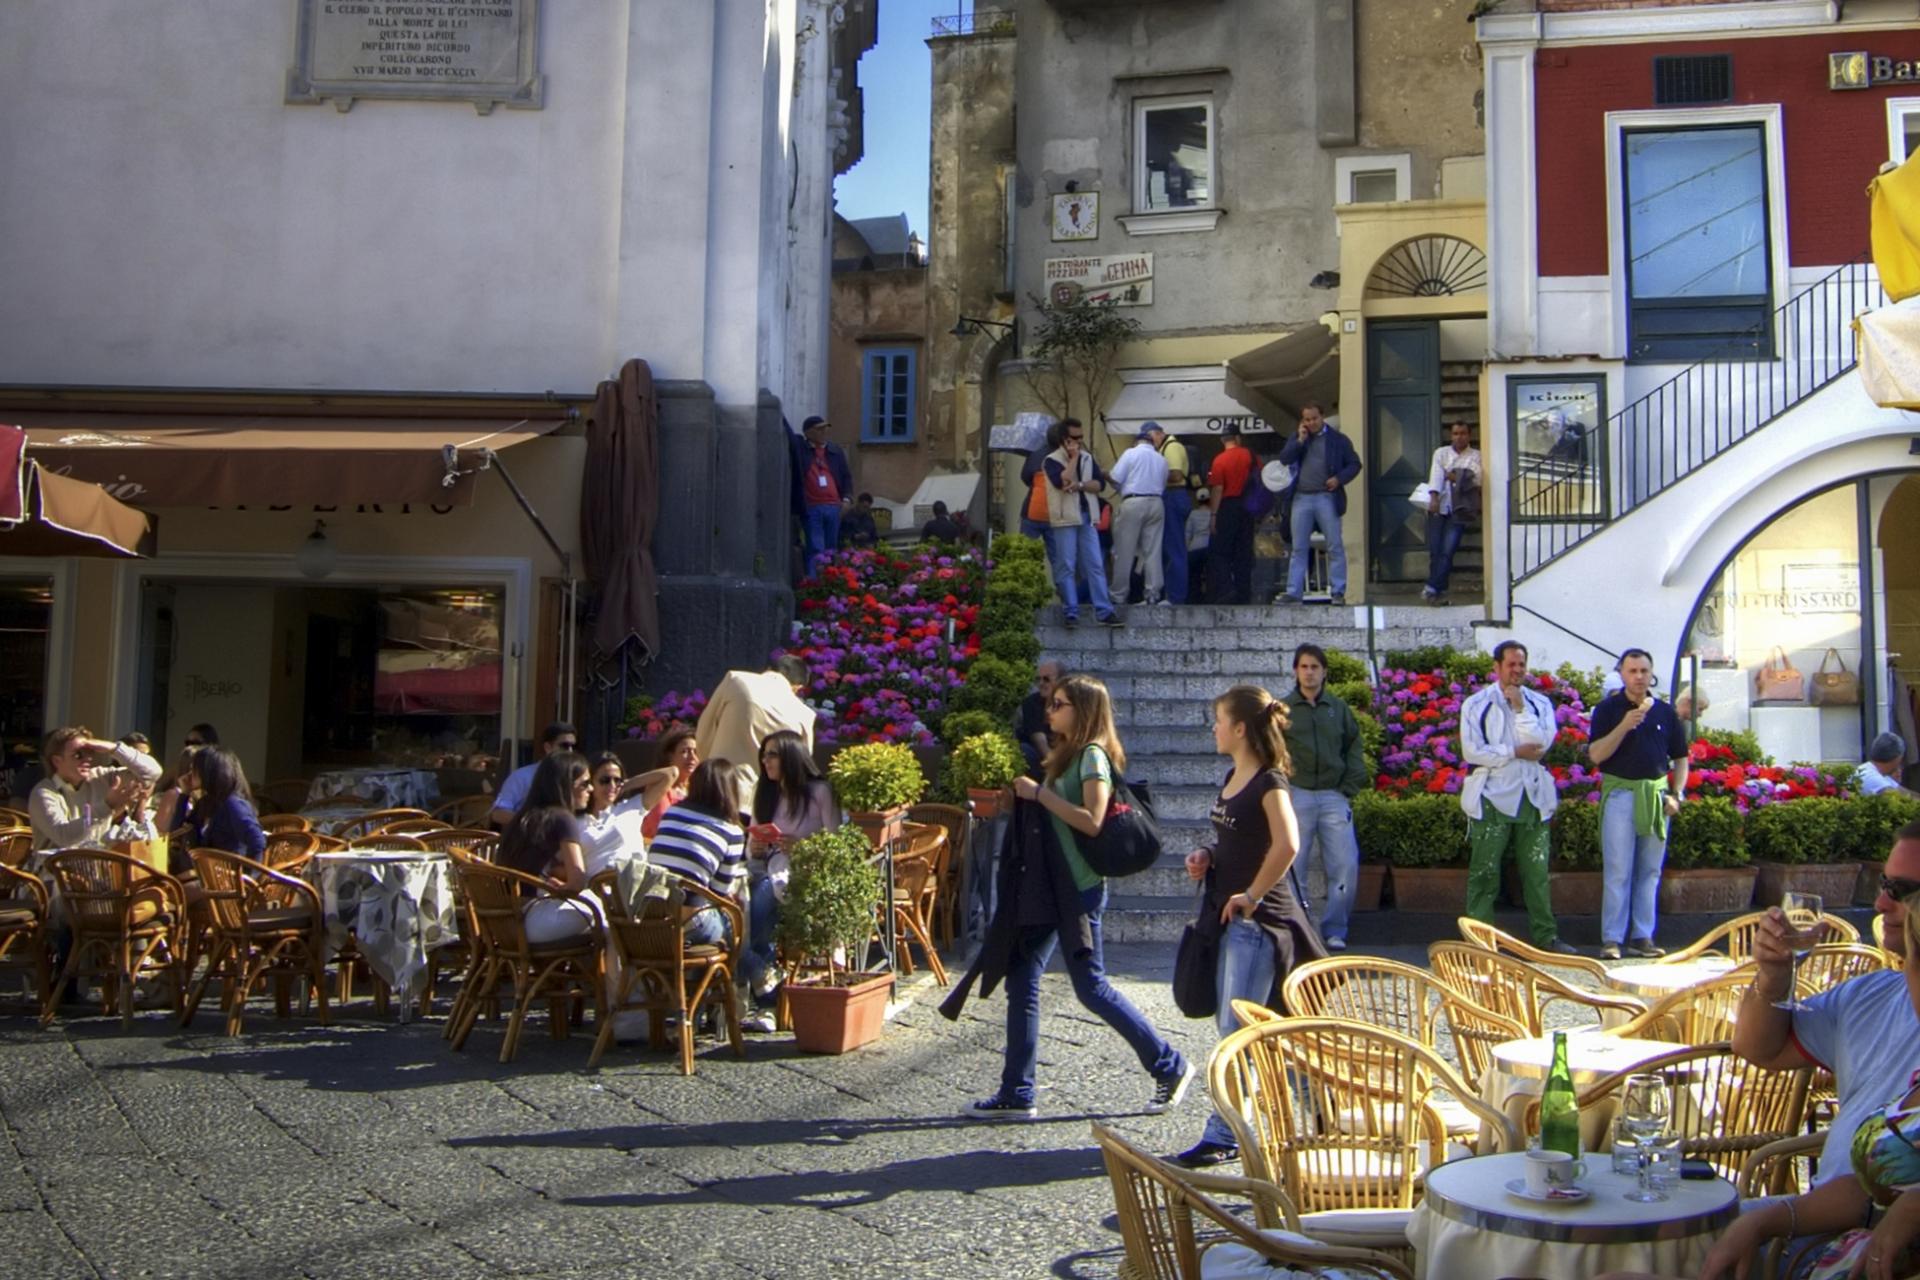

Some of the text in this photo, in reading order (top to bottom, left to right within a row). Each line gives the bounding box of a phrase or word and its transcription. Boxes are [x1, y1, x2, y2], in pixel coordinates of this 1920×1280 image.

[338, 5, 370, 15] CLERO
[386, 6, 423, 16] POPOLO
[426, 7, 445, 17] NEL
[368, 17, 468, 30] DALLA MORTE DI LEI
[379, 30, 456, 41] QUESTA LAPIDE
[361, 41, 471, 53] IMPERITURO RICORDO
[379, 54, 452, 65] COLLOCARONO
[378, 66, 412, 77] MARZO
[1047, 258, 1102, 269] RISTORANTE
[1047, 267, 1089, 279] PIZZERIA
